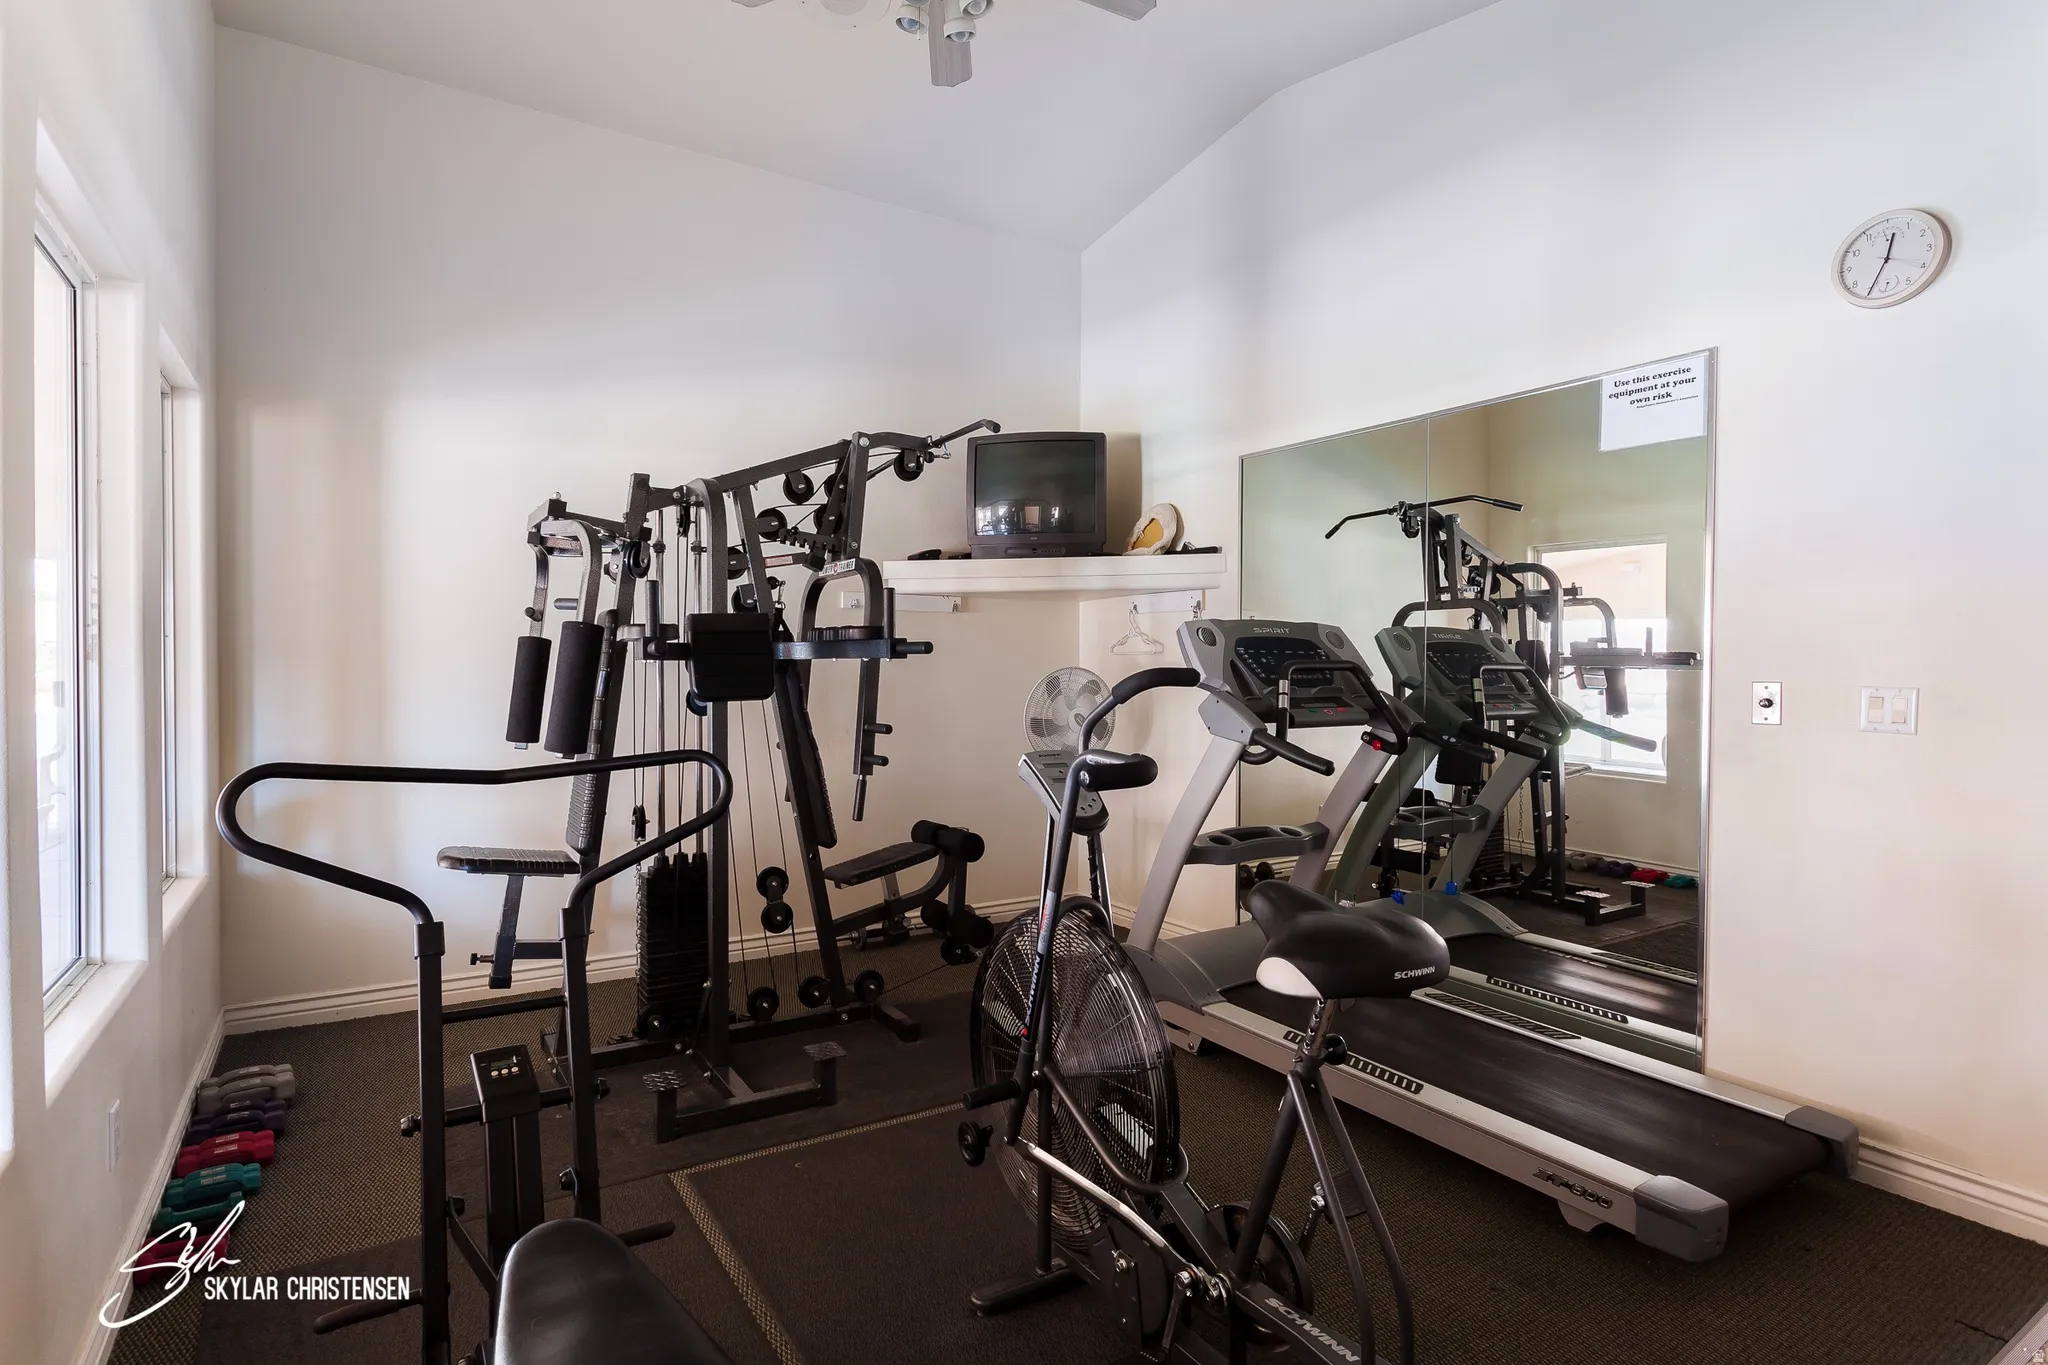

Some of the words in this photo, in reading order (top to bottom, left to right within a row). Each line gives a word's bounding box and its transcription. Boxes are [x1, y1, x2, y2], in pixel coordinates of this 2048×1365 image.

[1852, 249, 1861, 258] 10
[1613, 379, 1631, 388] Use
[1632, 375, 1650, 384] this
[1652, 366, 1692, 380] exercise
[1608, 383, 1658, 399] equipment
[1660, 381, 1671, 389] at
[1672, 376, 1697, 388] your
[1629, 396, 1650, 405] own
[1652, 391, 1672, 401] risk
[1394, 966, 1436, 980] SCHWINN
[1264, 1297, 1361, 1362] SCHWINN
